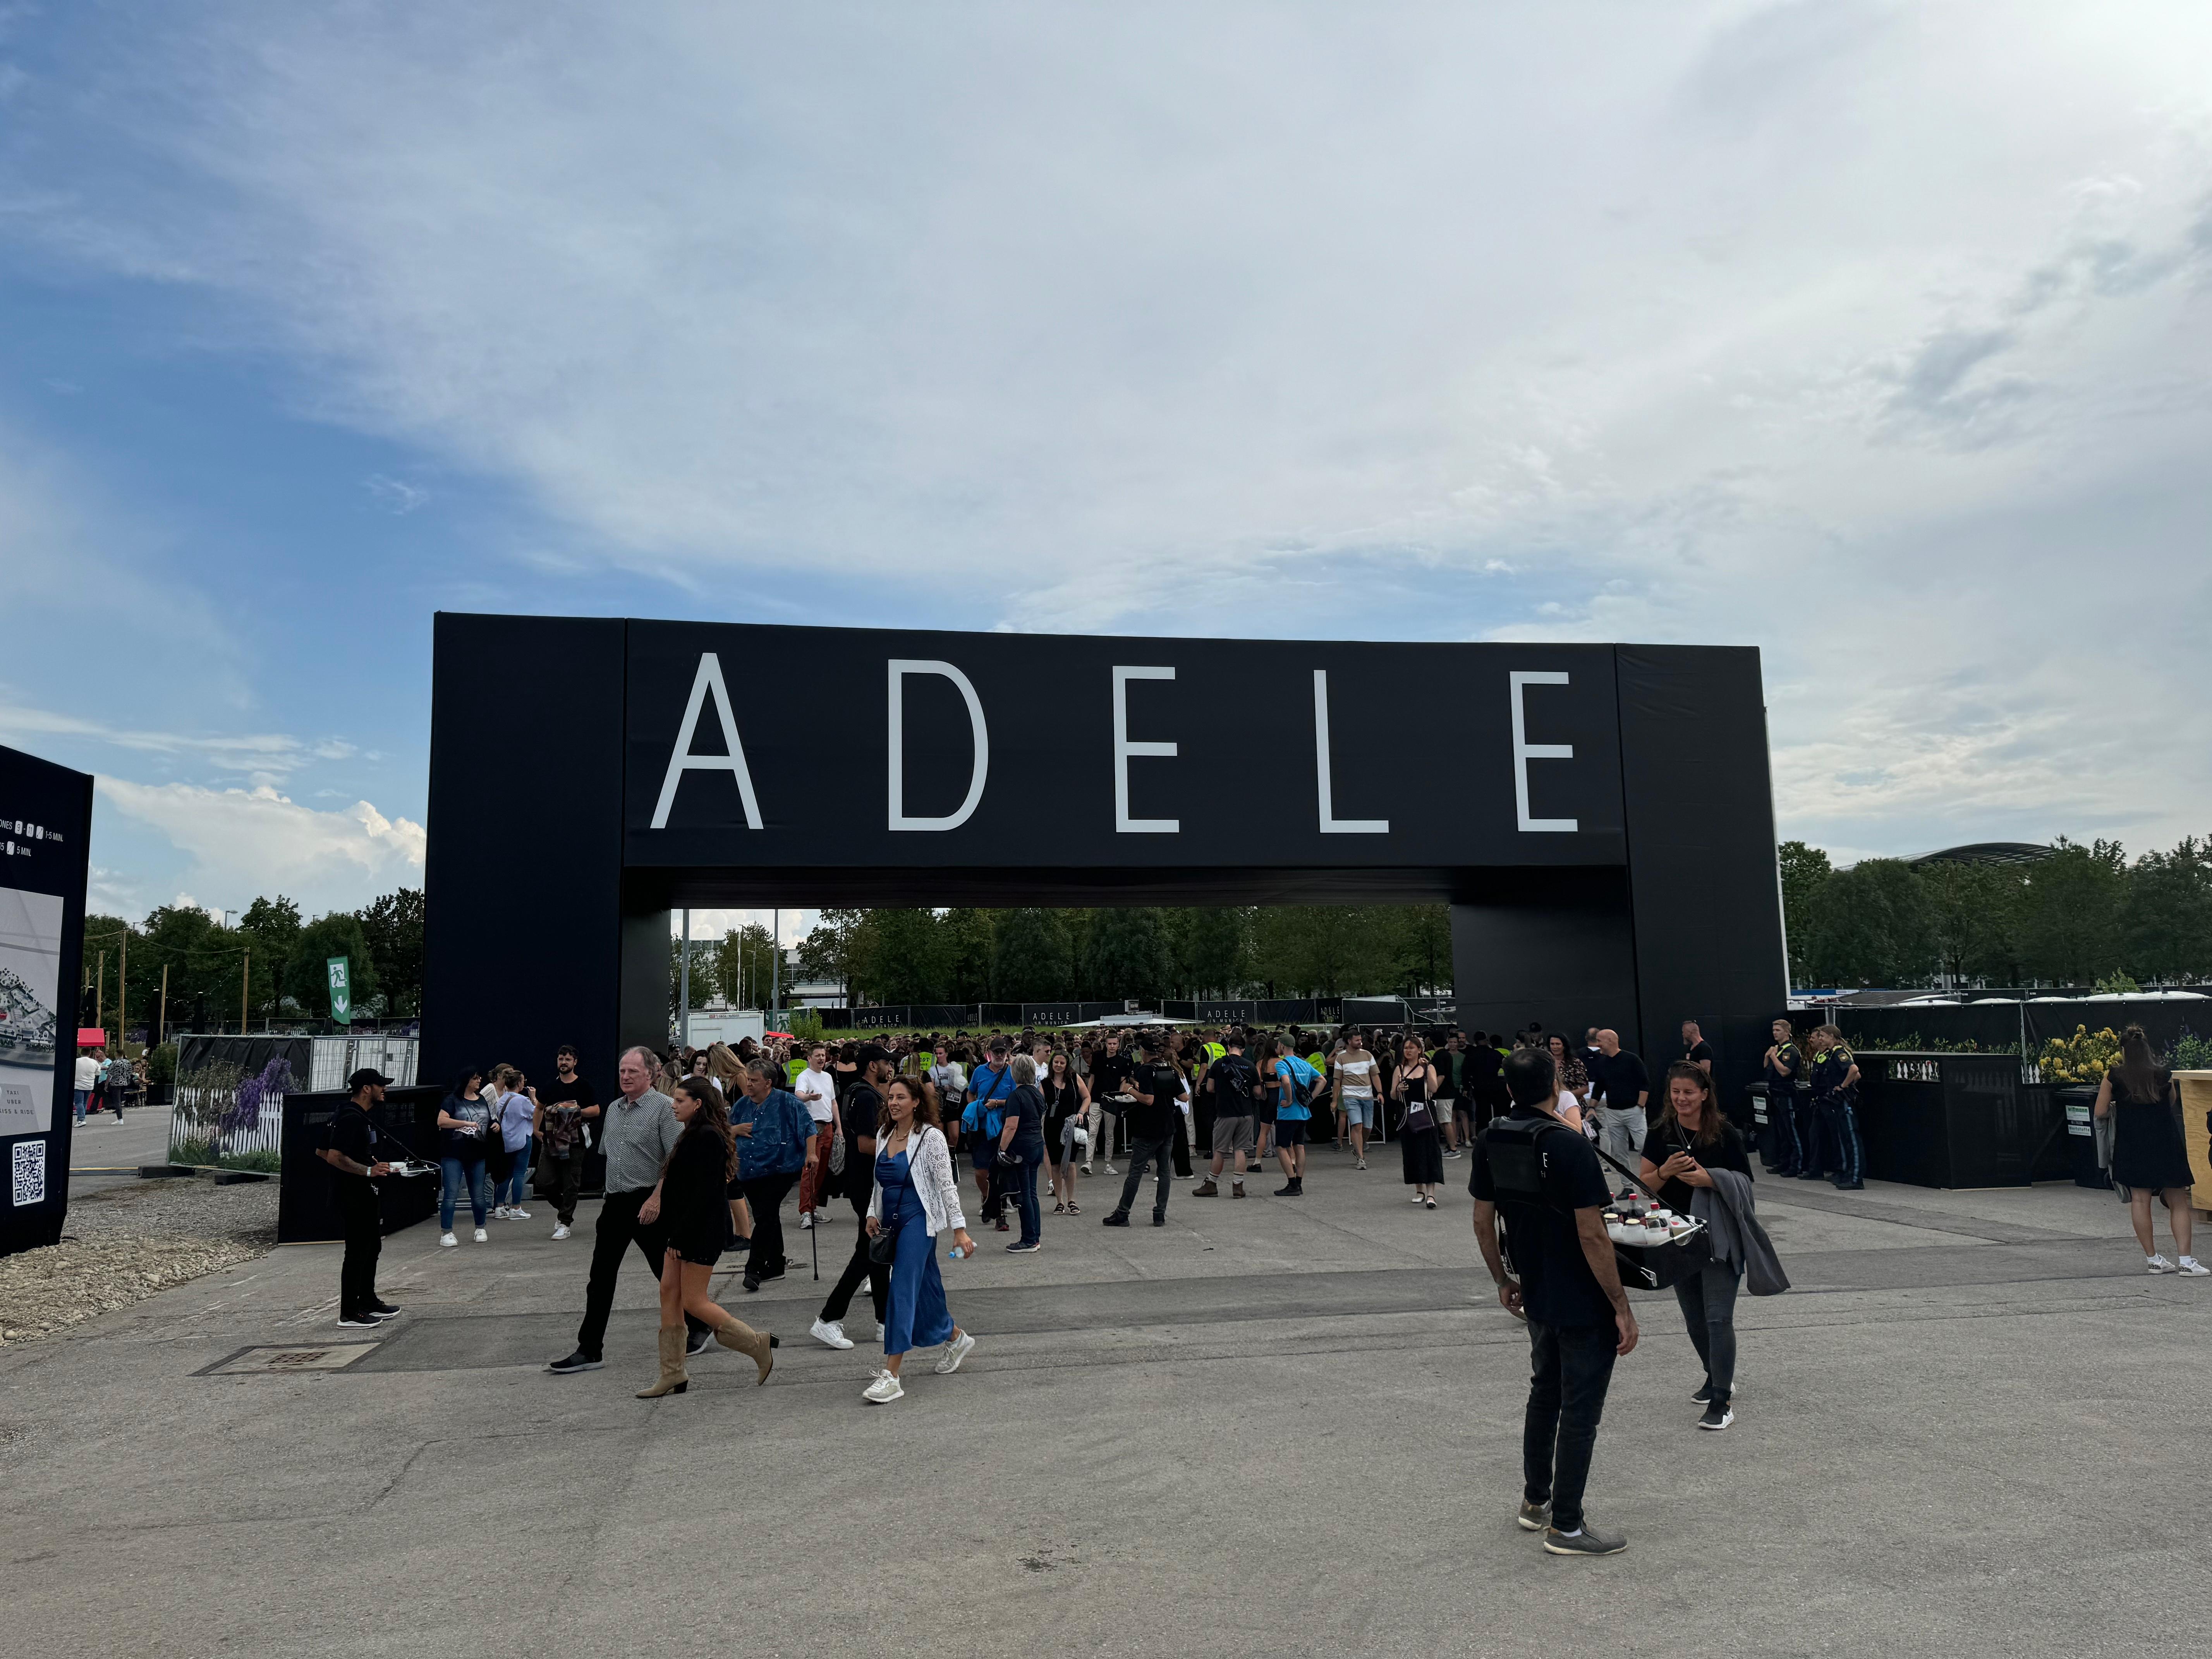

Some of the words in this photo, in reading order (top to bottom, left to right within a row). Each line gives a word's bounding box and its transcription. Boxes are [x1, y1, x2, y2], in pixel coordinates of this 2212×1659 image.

[649, 652, 1578, 833] ADELE
[28, 826, 32, 835] 11
[53, 833, 64, 842] MIN.
[17, 846, 20, 854] 5
[21, 847, 31, 857] MIN.
[1033, 1012, 1070, 1020] ADELE
[1207, 1010, 1245, 1018] ADELE
[864, 1015, 899, 1024] ADELE
